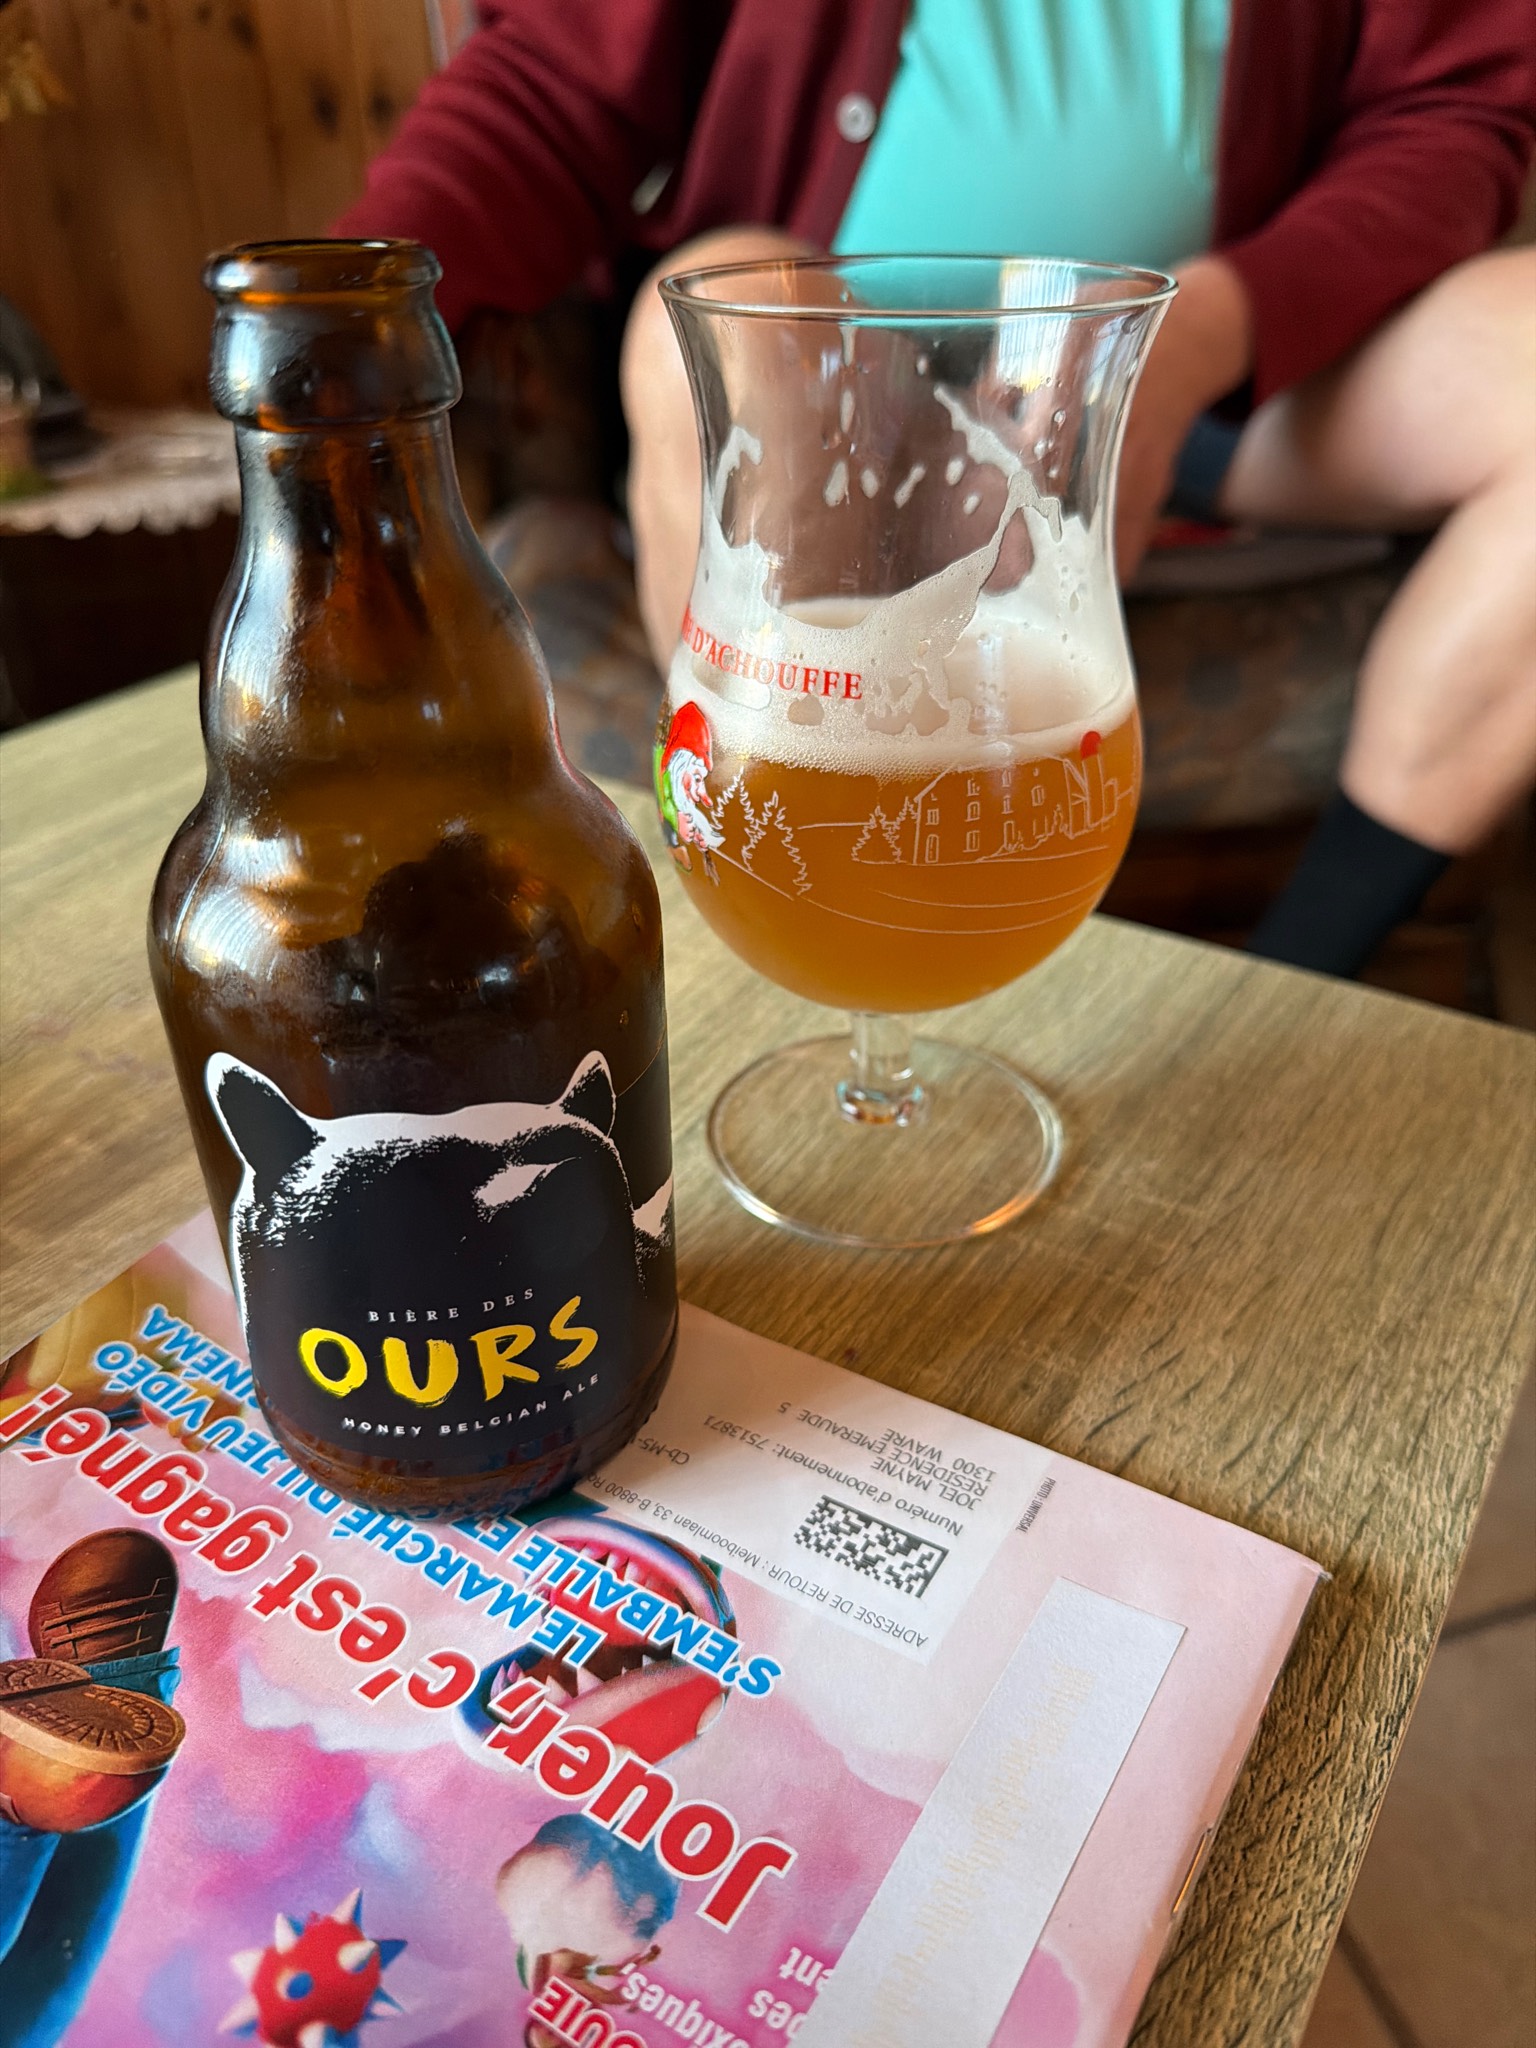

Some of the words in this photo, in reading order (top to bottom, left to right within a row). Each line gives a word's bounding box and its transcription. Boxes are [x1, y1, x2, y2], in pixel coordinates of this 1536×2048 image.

[367, 1308, 460, 1323] BIÈRE
[483, 1288, 534, 1313] DES
[299, 1295, 599, 1408] OURS
[94, 1341, 214, 1430] VIDÉO
[342, 1417, 422, 1436] HONEY
[439, 1400, 547, 1434] BELGIAN
[562, 1373, 600, 1401] ALE
[778, 1402, 791, 1414] 5
[201, 1417, 288, 1476] JEU
[703, 1415, 765, 1450] 7513871
[796, 1409, 887, 1454] EMERAUDE
[881, 1428, 945, 1462] WAVRE
[772, 1443, 892, 1503] d'abonnement:
[870, 1457, 933, 1491] MAYNE
[888, 1451, 988, 1497] RESIDENCE
[952, 1457, 996, 1482] 1300
[1037, 1476, 1056, 1499] PHOTO
[605, 1481, 651, 1511] B-8800
[653, 1503, 673, 1520] 33,
[939, 1489, 982, 1511] JOEL
[895, 1498, 964, 1537] Numéro
[1015, 1499, 1044, 1534] UNIVERSAL
[673, 1514, 760, 1567] Meiboomlaan
[329, 1506, 549, 1632] MARCHÉ
[768, 1567, 830, 1602] RETOUR
[513, 1532, 782, 1696] S'EMBALLE
[832, 1594, 854, 1615] DE
[251, 1551, 480, 1711] c'est
[532, 1608, 608, 1668] LE
[854, 1606, 929, 1648] ADRESSE
[483, 1677, 797, 1932] Jouer,
